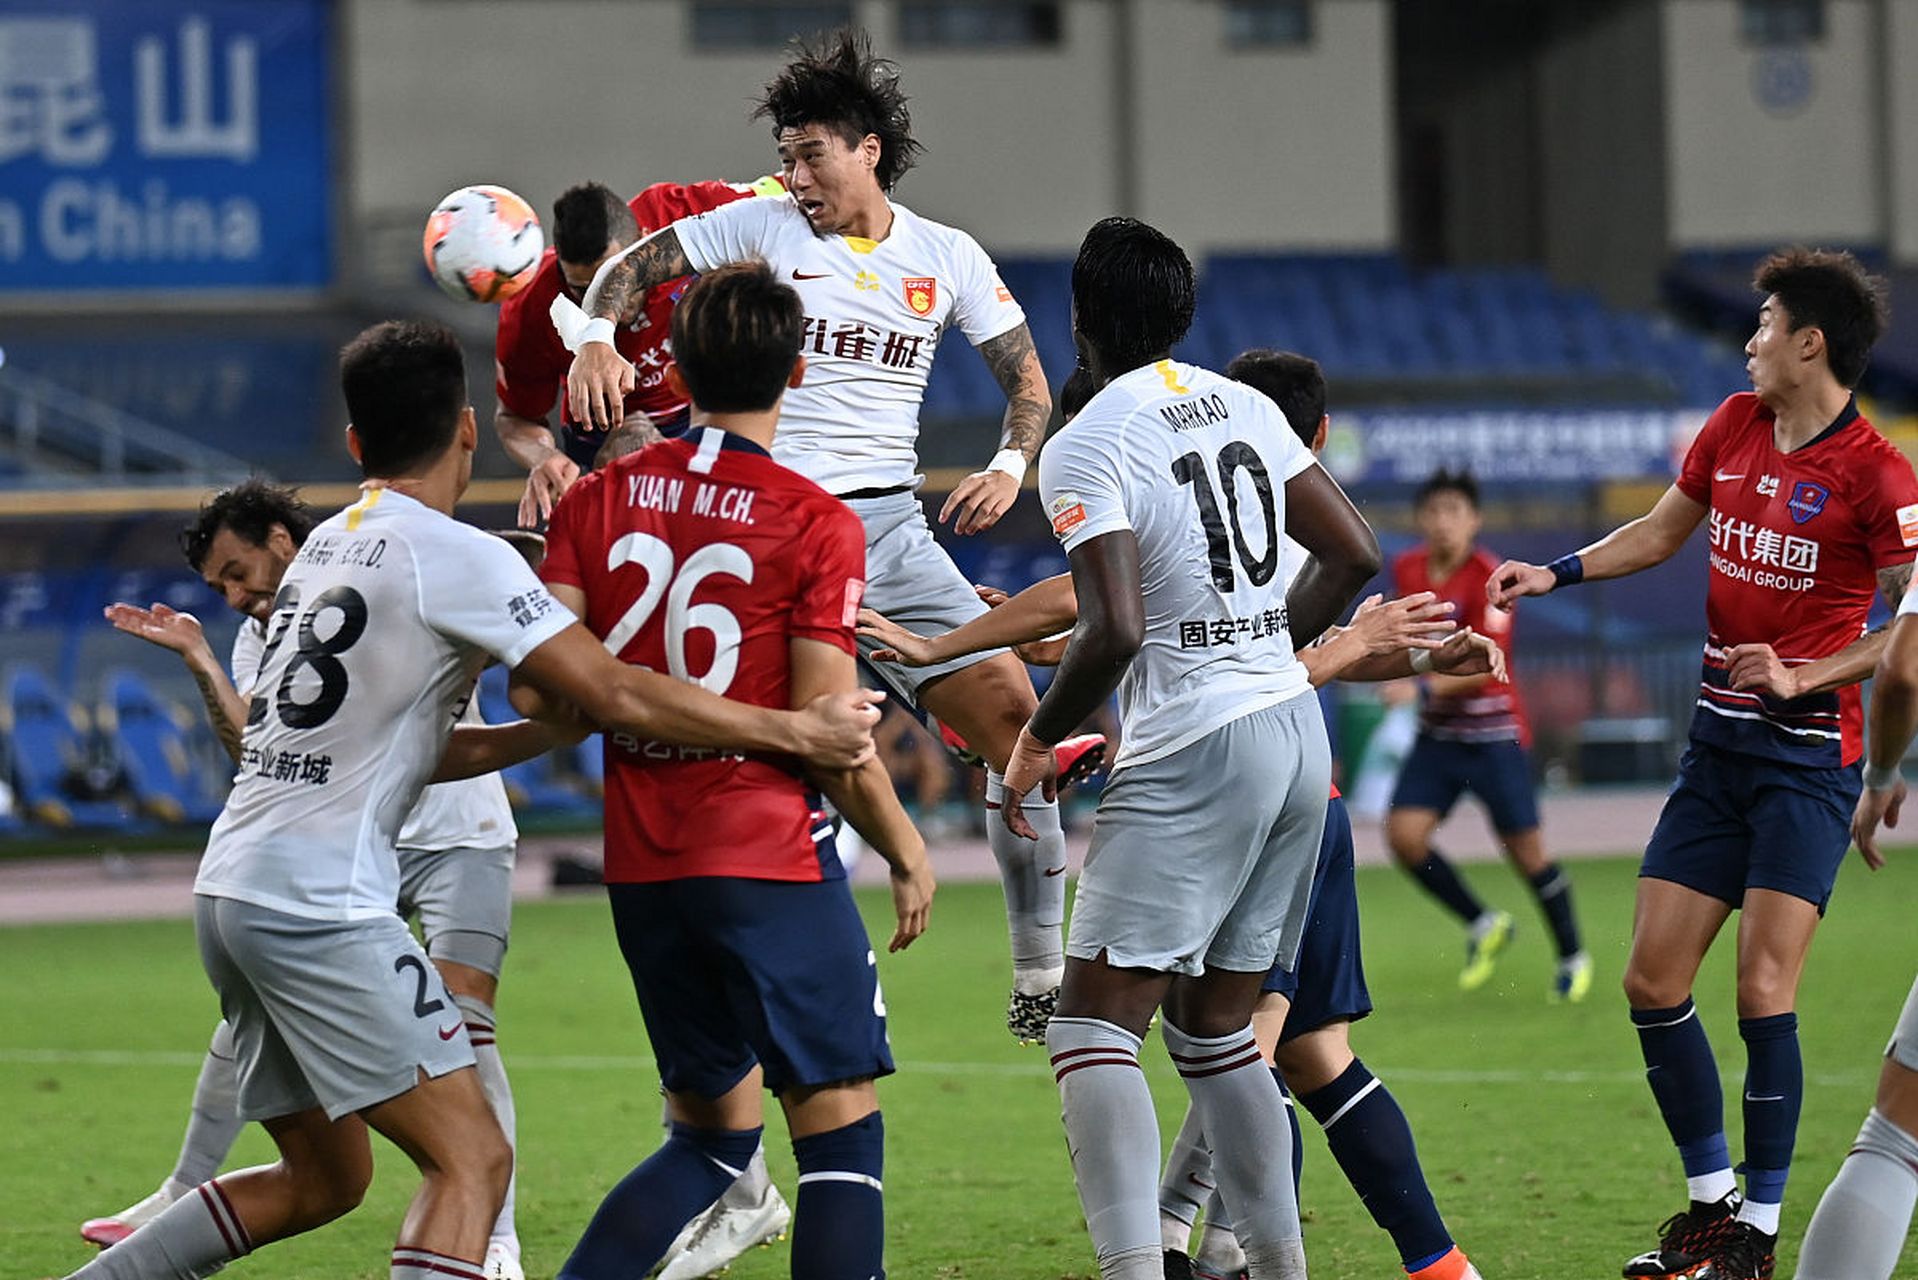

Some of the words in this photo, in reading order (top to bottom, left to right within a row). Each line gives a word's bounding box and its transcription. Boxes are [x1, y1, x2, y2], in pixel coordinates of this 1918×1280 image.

[41, 177, 262, 262] China
[1160, 394, 1228, 433] MARKAO
[628, 475, 684, 514] YUAN
[692, 483, 755, 525] M.CH.
[1171, 441, 1278, 593] 10
[603, 532, 754, 697] 26
[1754, 570, 1815, 592] GROUP
[247, 584, 368, 730] 28
